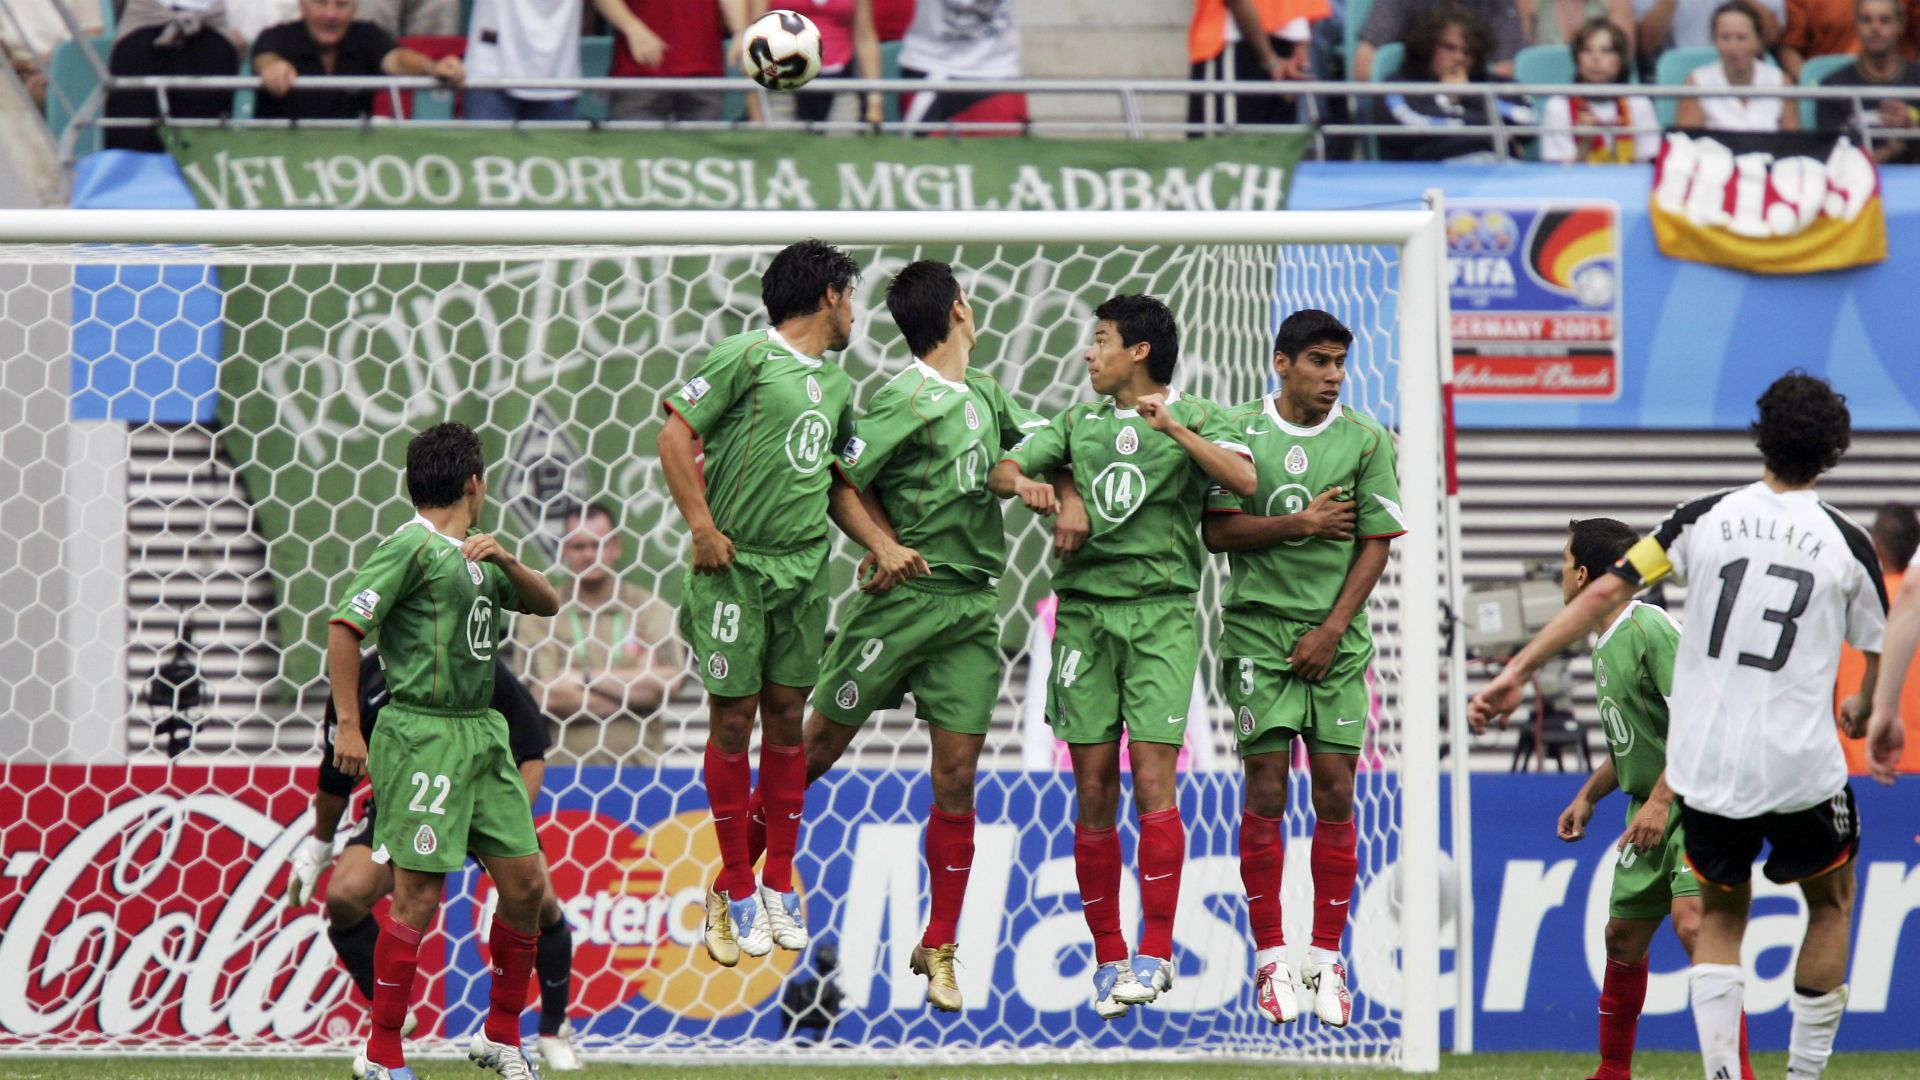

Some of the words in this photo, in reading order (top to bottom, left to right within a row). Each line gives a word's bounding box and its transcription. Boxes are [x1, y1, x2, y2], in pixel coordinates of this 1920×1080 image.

[471, 156, 817, 208] BORUSSIA
[836, 161, 1286, 210] M'GLADBACH
[1449, 257, 1517, 286] FIFA
[798, 419, 825, 462] 13
[1104, 471, 1133, 511] 14
[1720, 519, 1828, 561] BALLACK
[473, 606, 492, 649] 22
[711, 600, 741, 643] 13
[1707, 557, 1815, 672] 13
[856, 637, 884, 673] 9
[1056, 645, 1082, 688] 14
[1239, 657, 1255, 695] 3
[408, 771, 451, 815] 22
